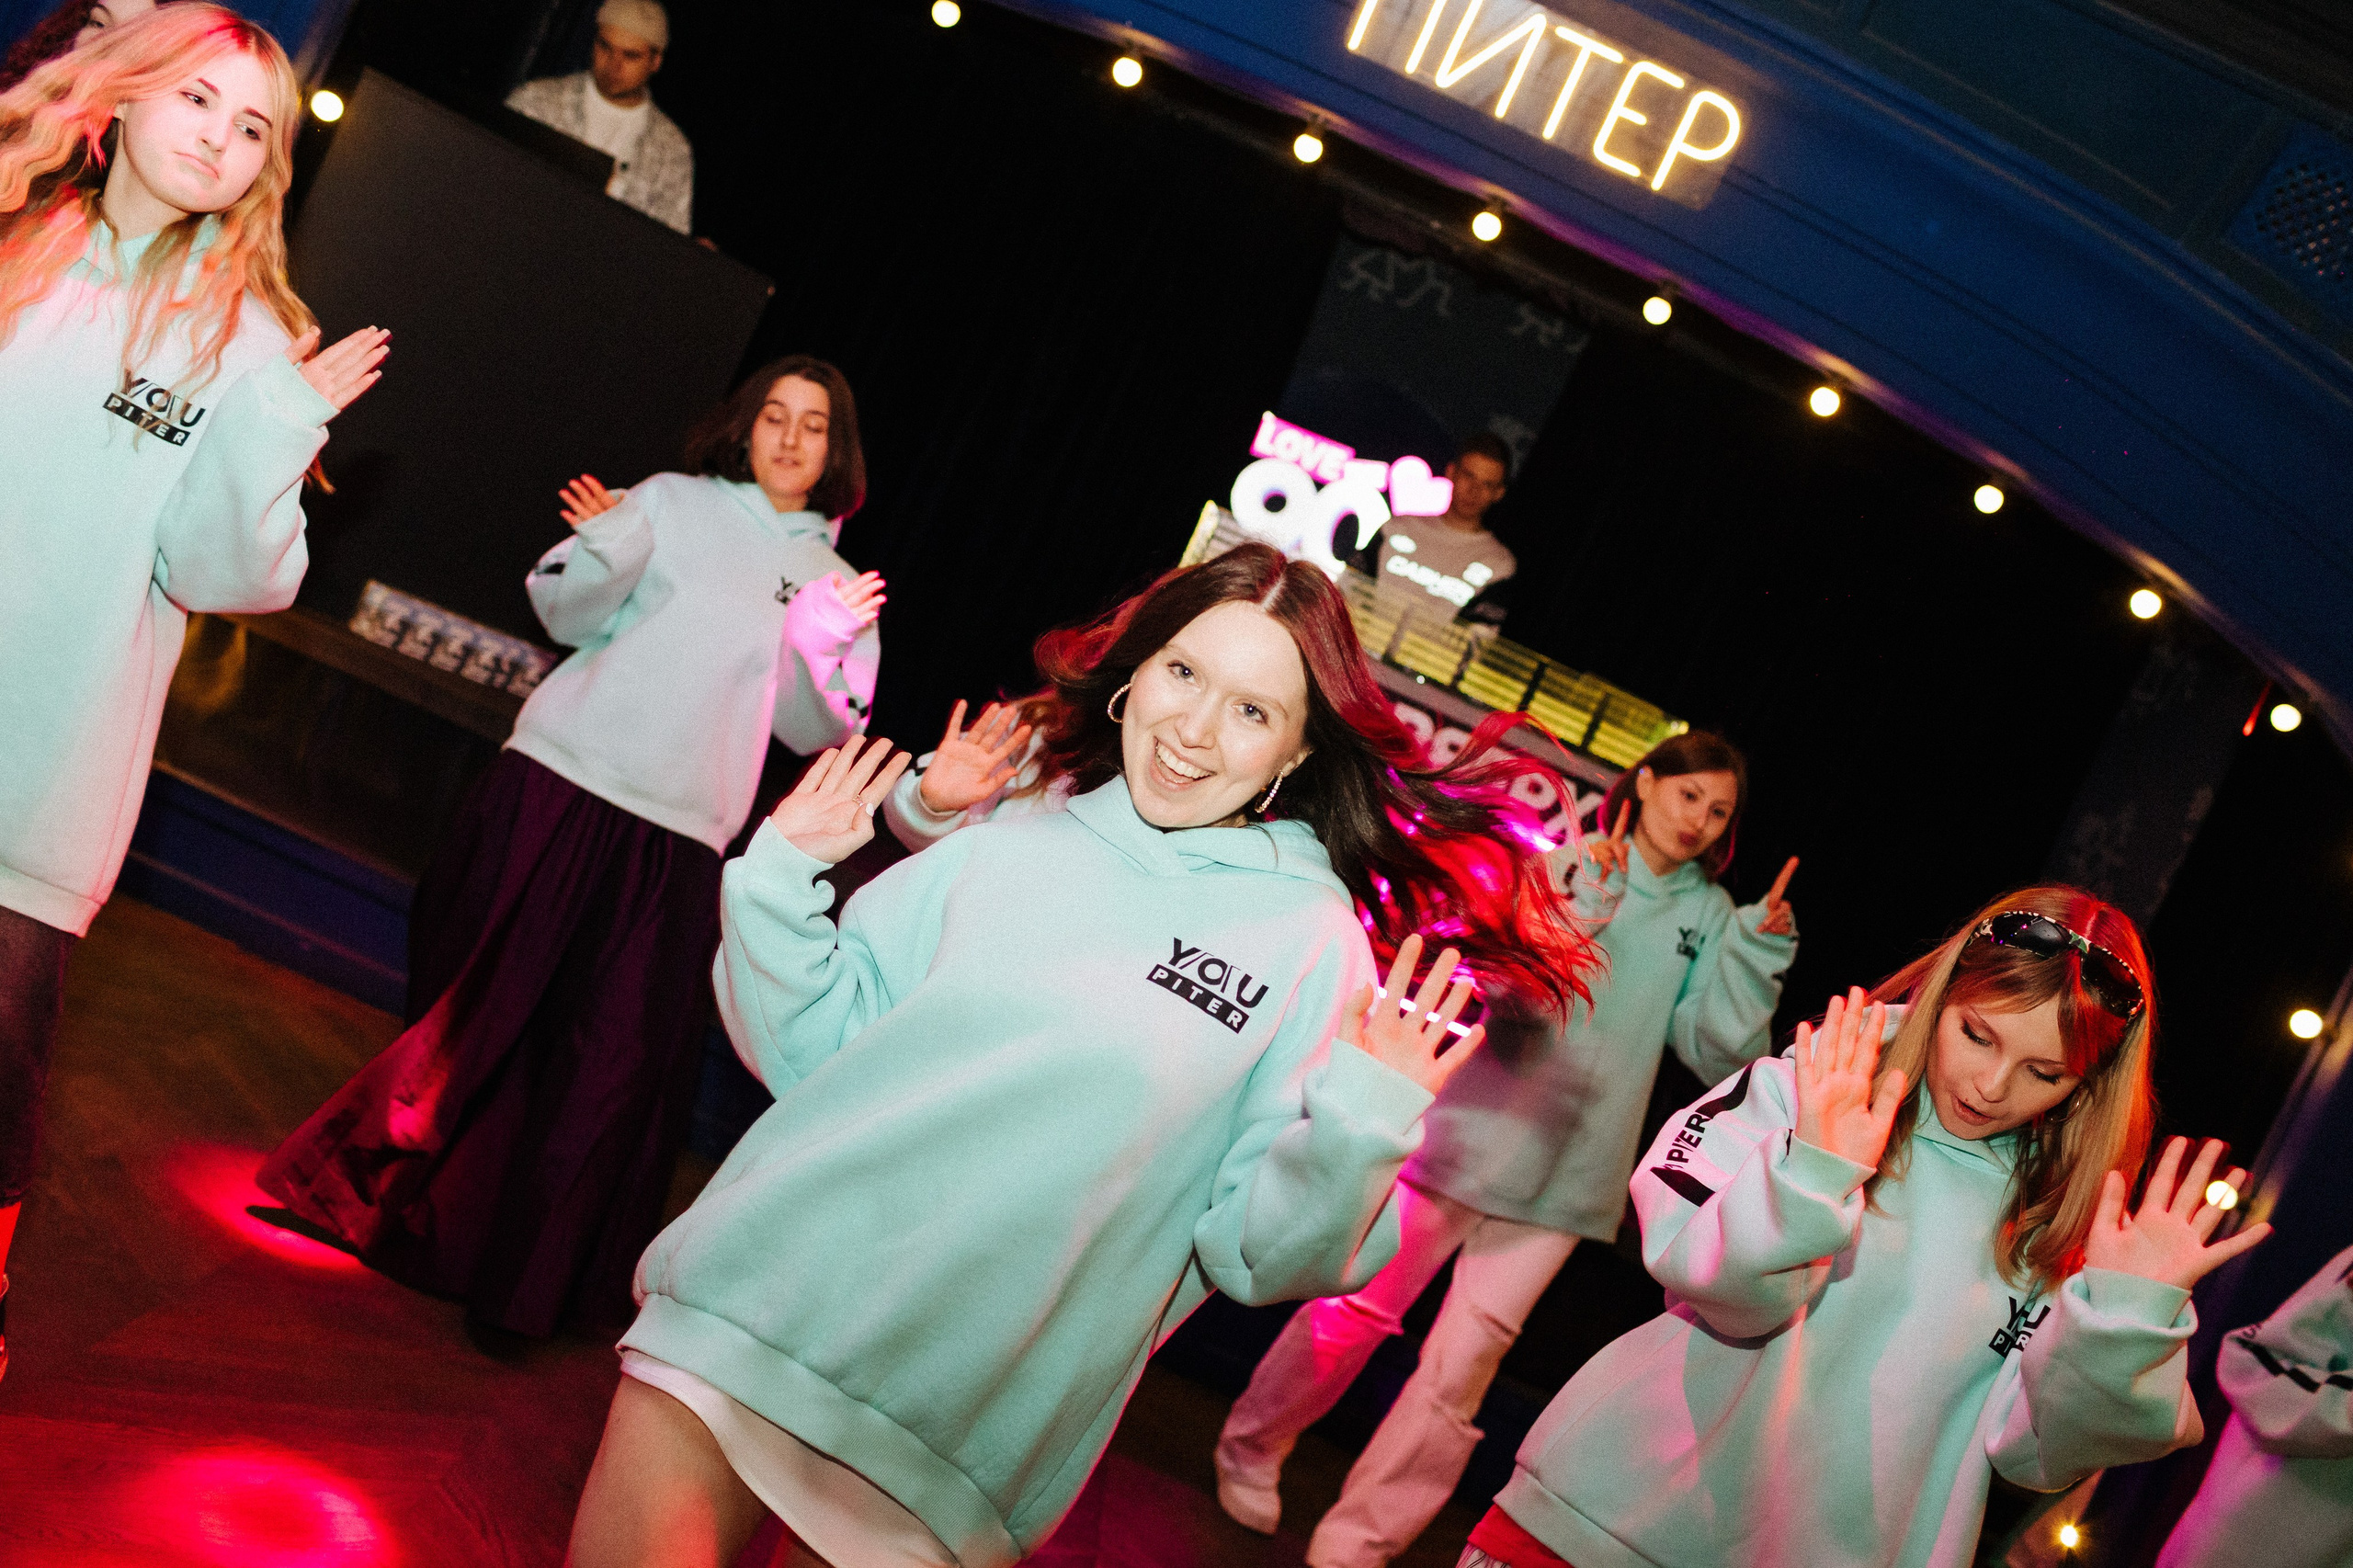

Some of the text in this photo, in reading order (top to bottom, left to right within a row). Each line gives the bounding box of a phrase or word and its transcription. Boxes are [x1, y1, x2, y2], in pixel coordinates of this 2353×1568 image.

[106, 394, 188, 445] PITER
[120, 369, 207, 428] YOU
[1251, 411, 1357, 483] LOVE
[1150, 967, 1245, 1029] PITER
[1168, 937, 1269, 1009] YOU
